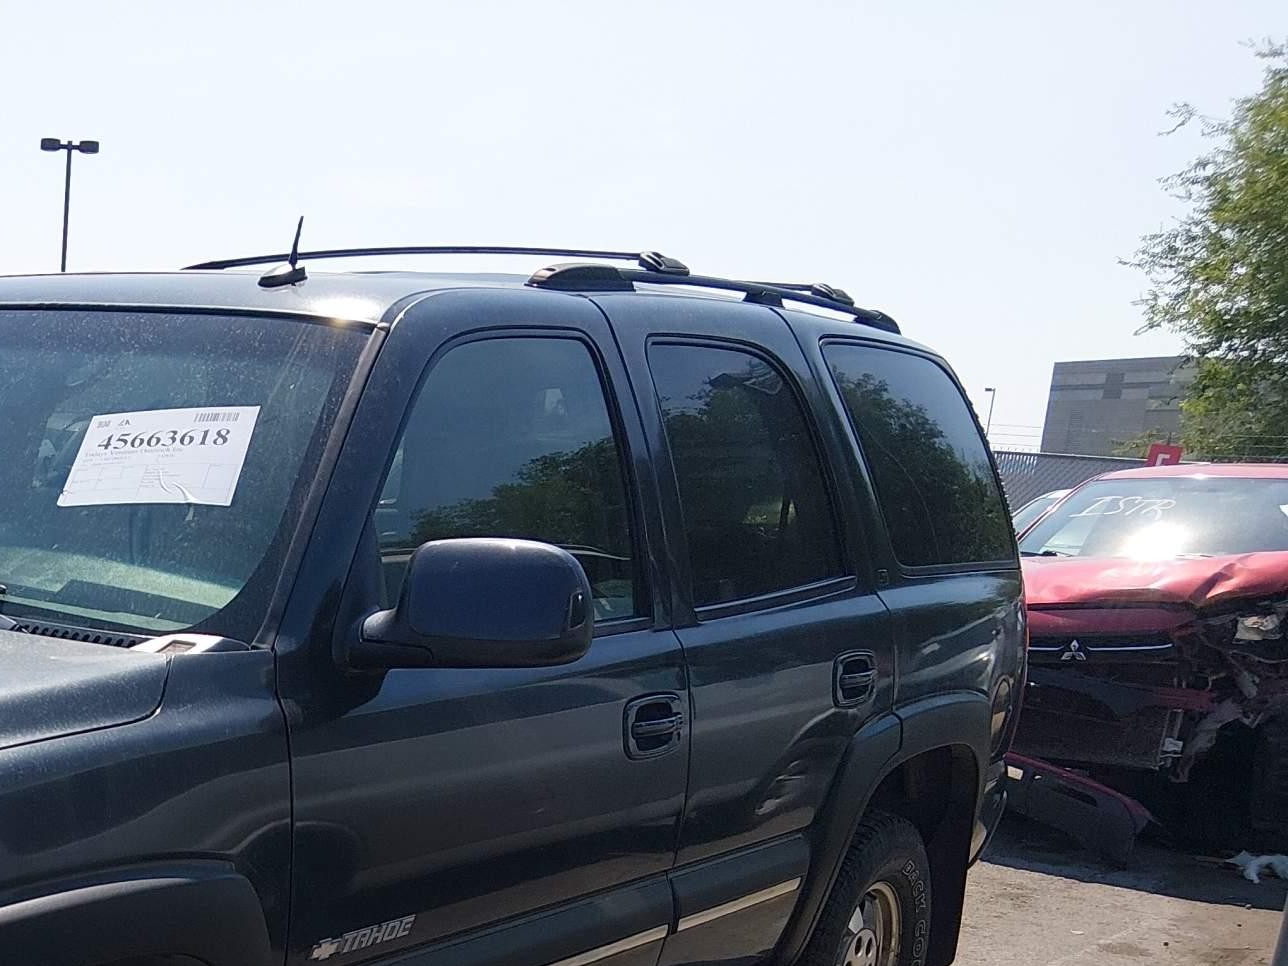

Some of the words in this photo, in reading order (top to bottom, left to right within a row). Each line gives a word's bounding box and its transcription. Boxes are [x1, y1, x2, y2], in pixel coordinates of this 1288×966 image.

[97, 427, 232, 450] 45663618
[902, 859, 927, 913] BACK
[342, 913, 416, 953] TAHOE
